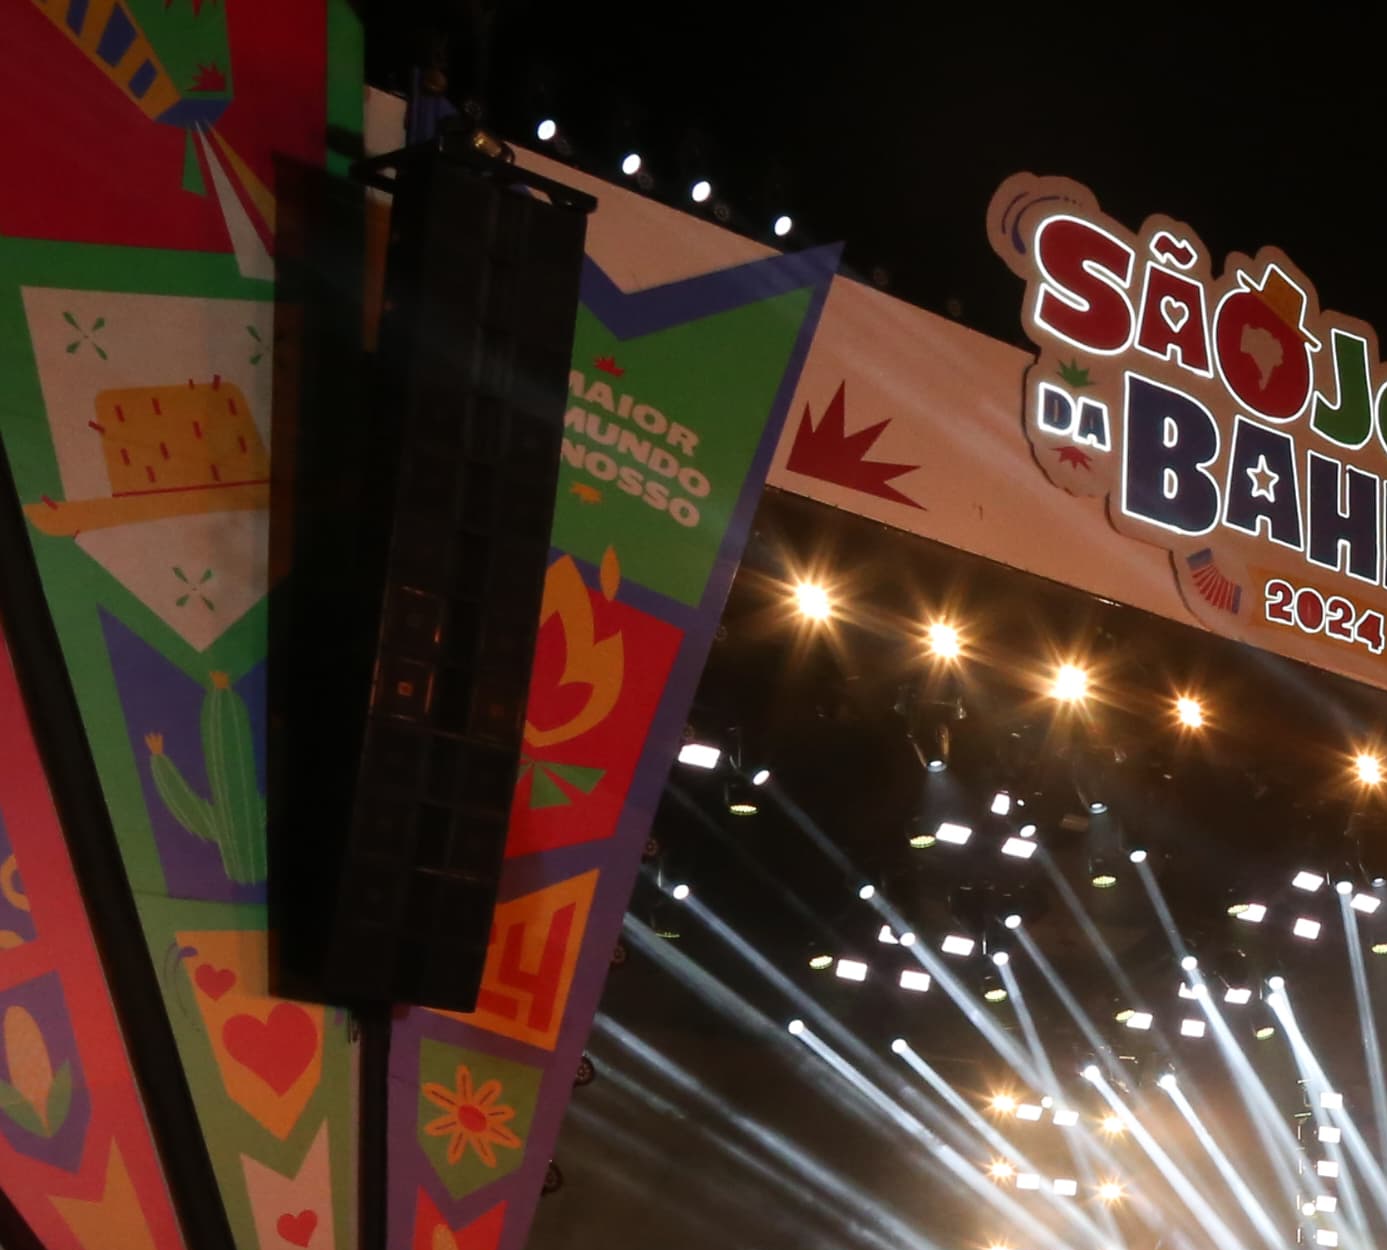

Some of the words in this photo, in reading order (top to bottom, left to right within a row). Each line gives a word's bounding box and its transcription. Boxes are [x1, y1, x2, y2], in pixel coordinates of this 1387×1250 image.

[1034, 214, 1314, 423] SÃO
[1038, 382, 1111, 451] DA
[560, 438, 700, 527] NOSSO
[1265, 580, 1385, 653] 2024
[475, 902, 577, 1034] 4
